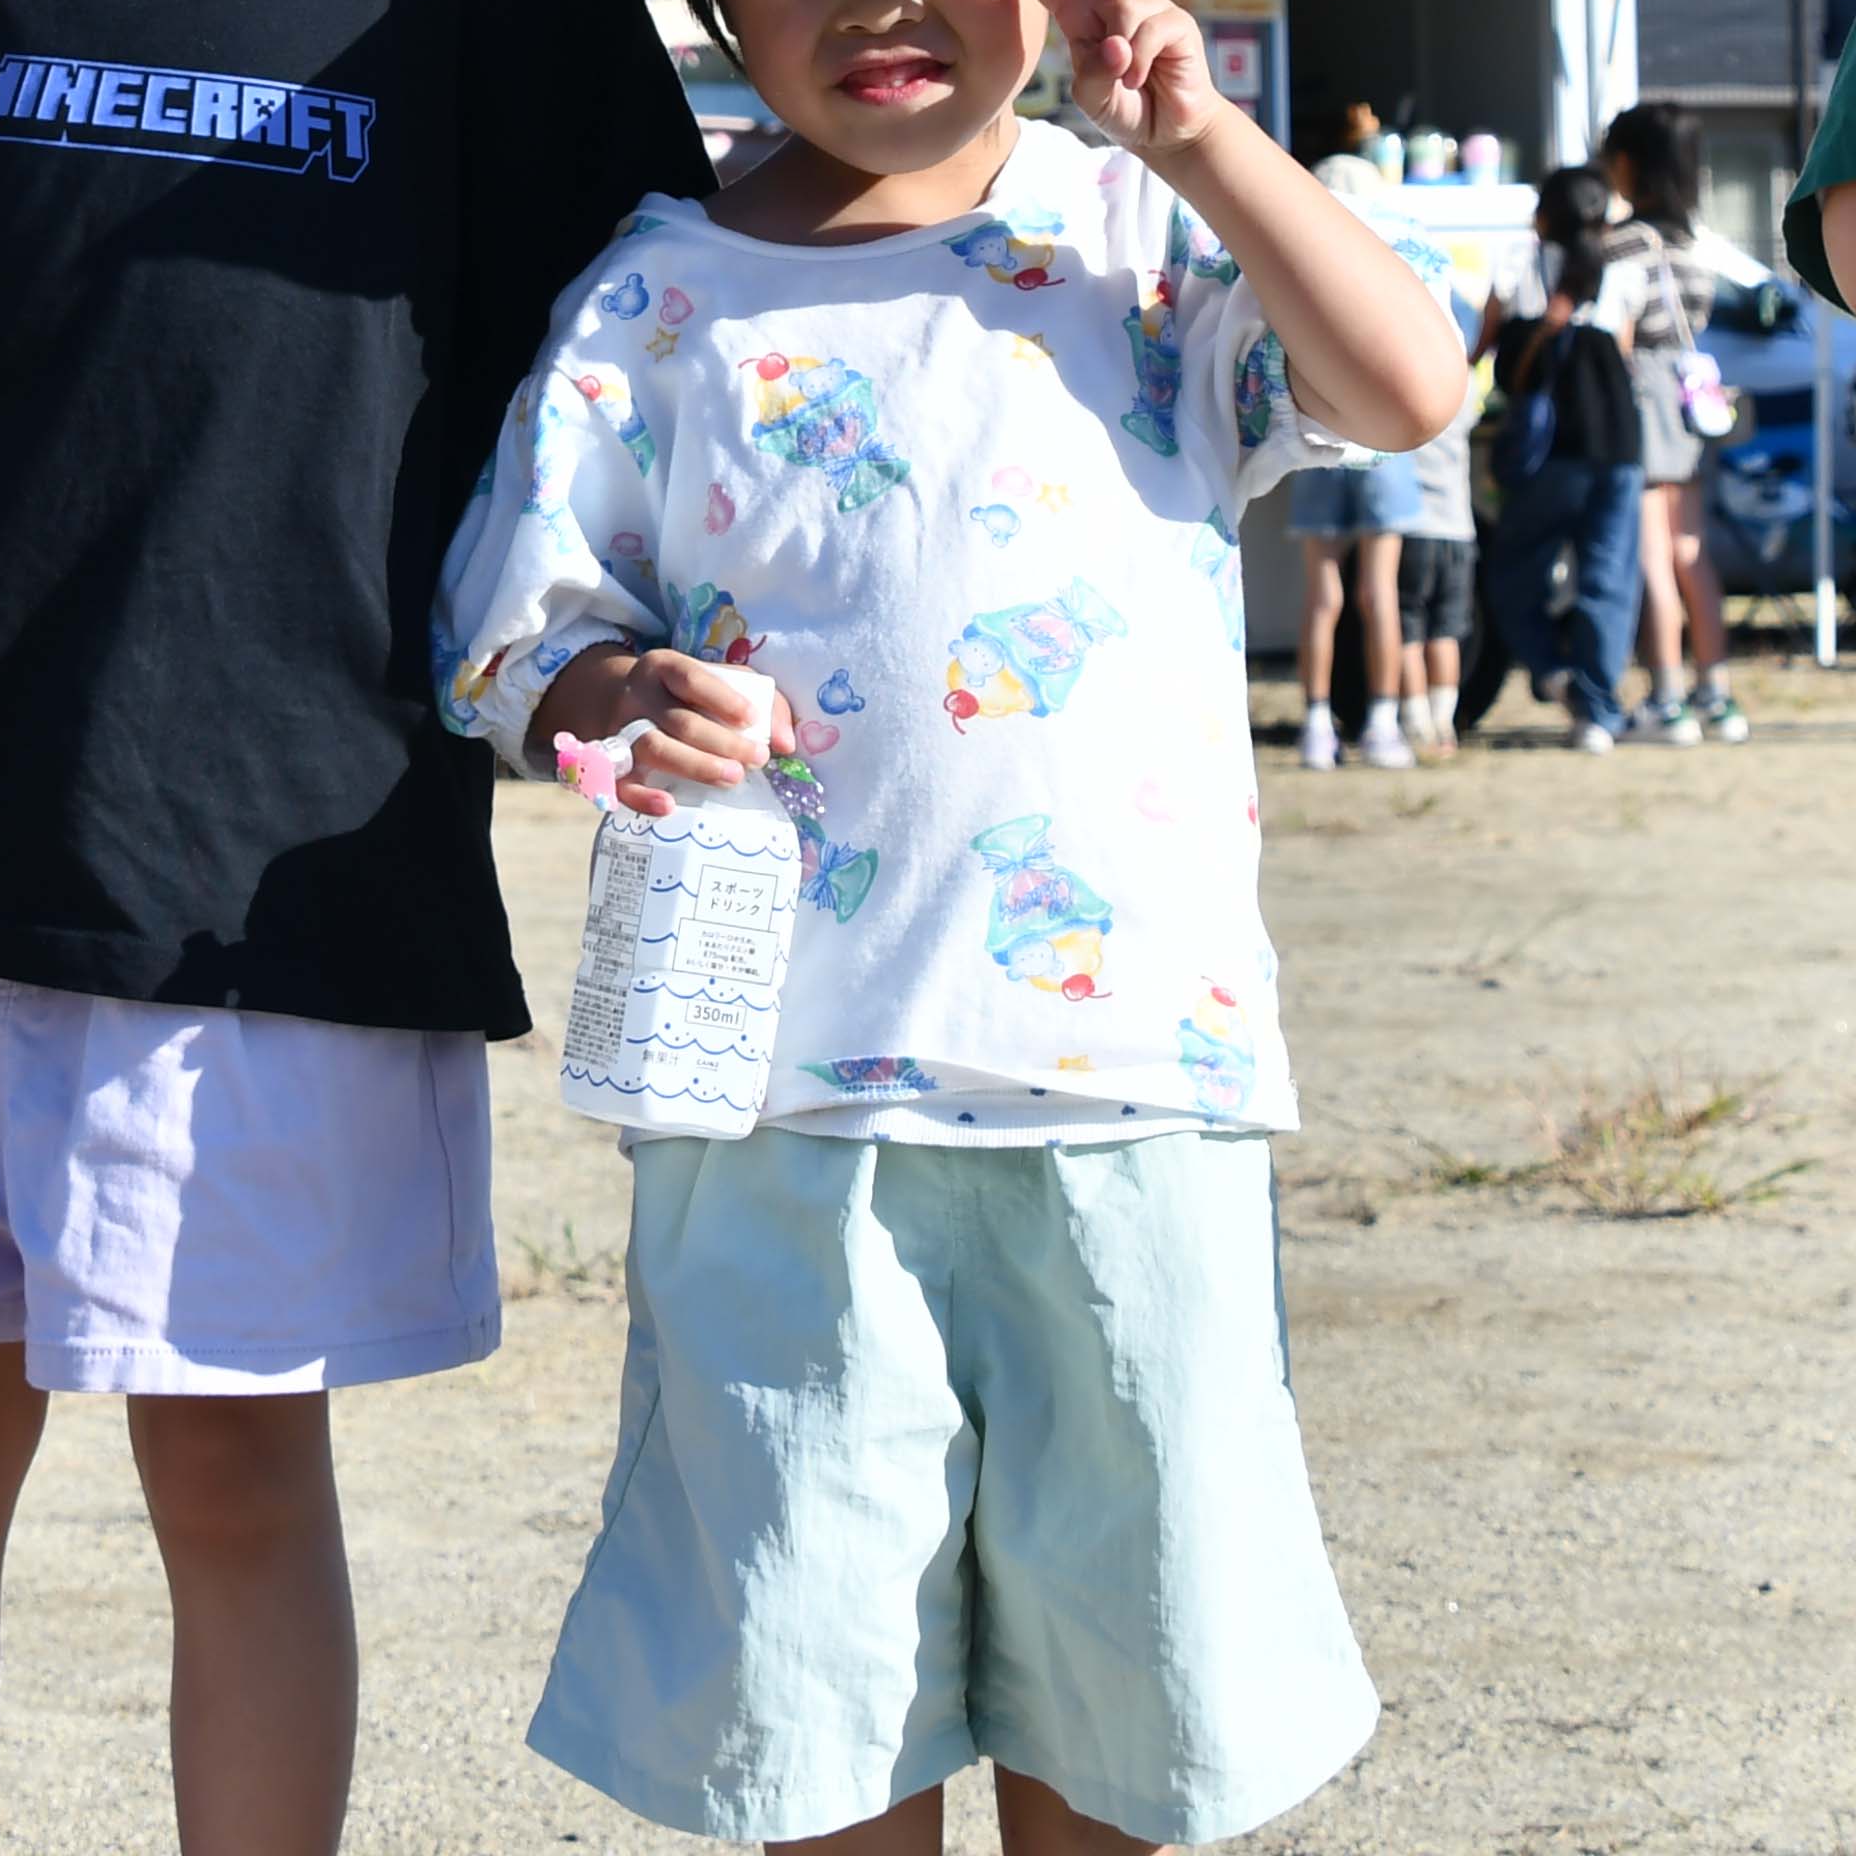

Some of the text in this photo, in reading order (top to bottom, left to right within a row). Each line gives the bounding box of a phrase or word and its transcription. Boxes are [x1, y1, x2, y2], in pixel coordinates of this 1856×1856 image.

[711, 880, 764, 900] スポーツ
[710, 897, 761, 916] ドリンク
[693, 1004, 740, 1025] 350ml
